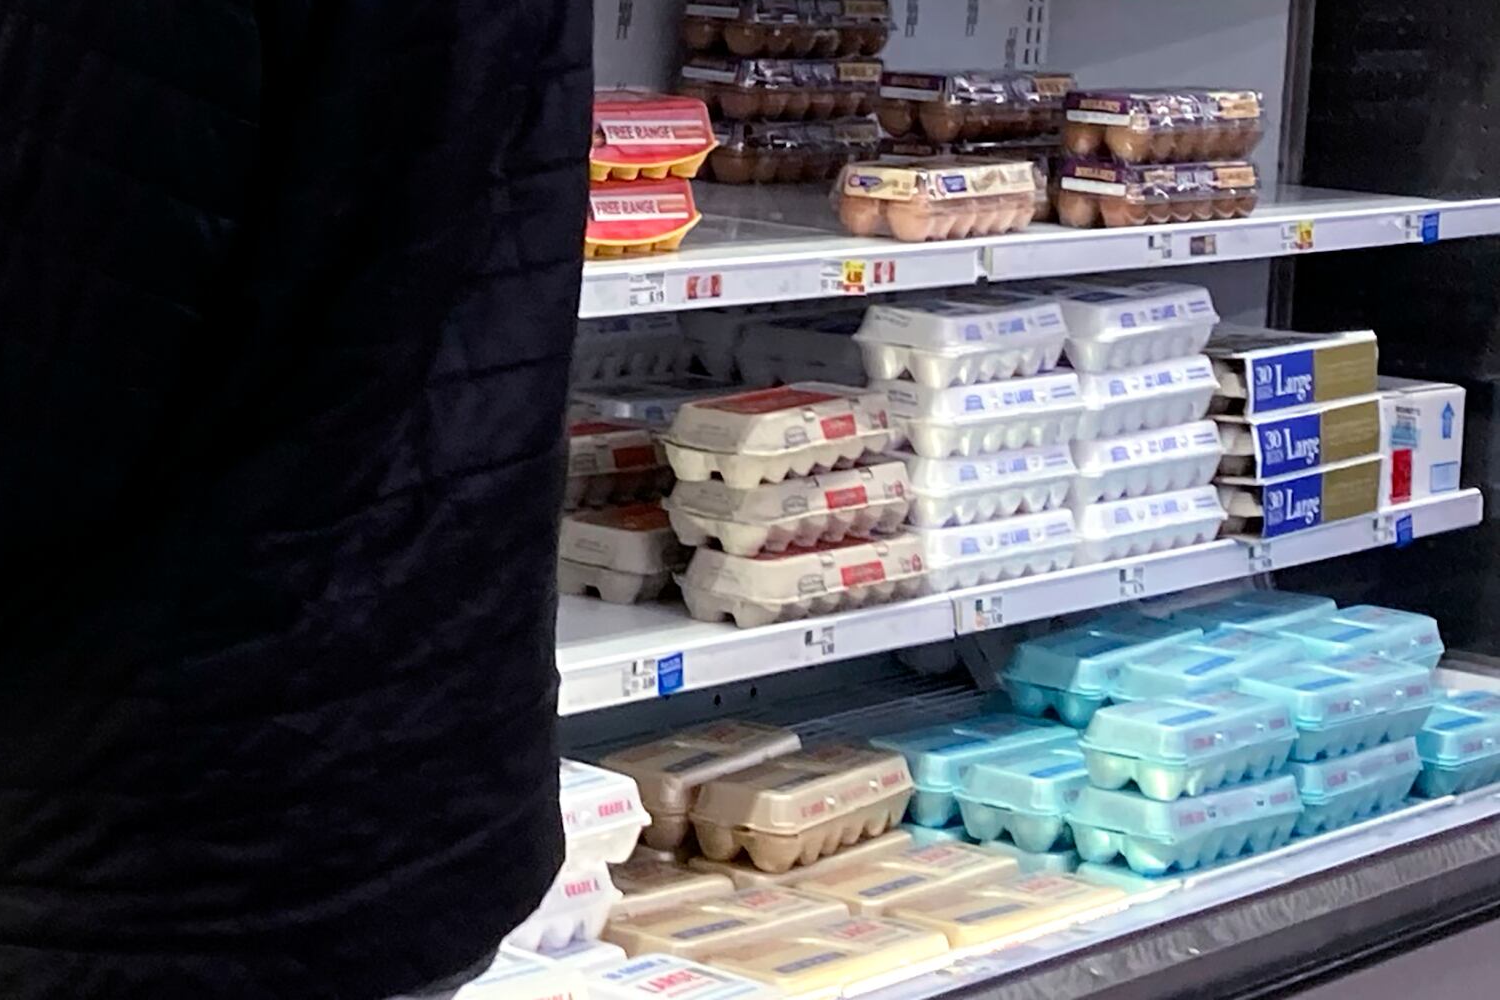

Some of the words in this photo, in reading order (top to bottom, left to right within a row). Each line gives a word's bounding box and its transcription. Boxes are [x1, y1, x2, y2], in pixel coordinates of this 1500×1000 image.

[605, 125, 635, 139] FREE
[635, 124, 671, 139] RANGE
[594, 201, 621, 215] FREE
[622, 200, 657, 214] RANGE
[1255, 365, 1273, 385] 30
[1275, 363, 1313, 402] Large
[1265, 429, 1282, 451] 30
[1284, 428, 1320, 465] Large
[1268, 490, 1284, 511] 30
[1286, 488, 1320, 525] Large
[598, 802, 625, 818] GRADE
